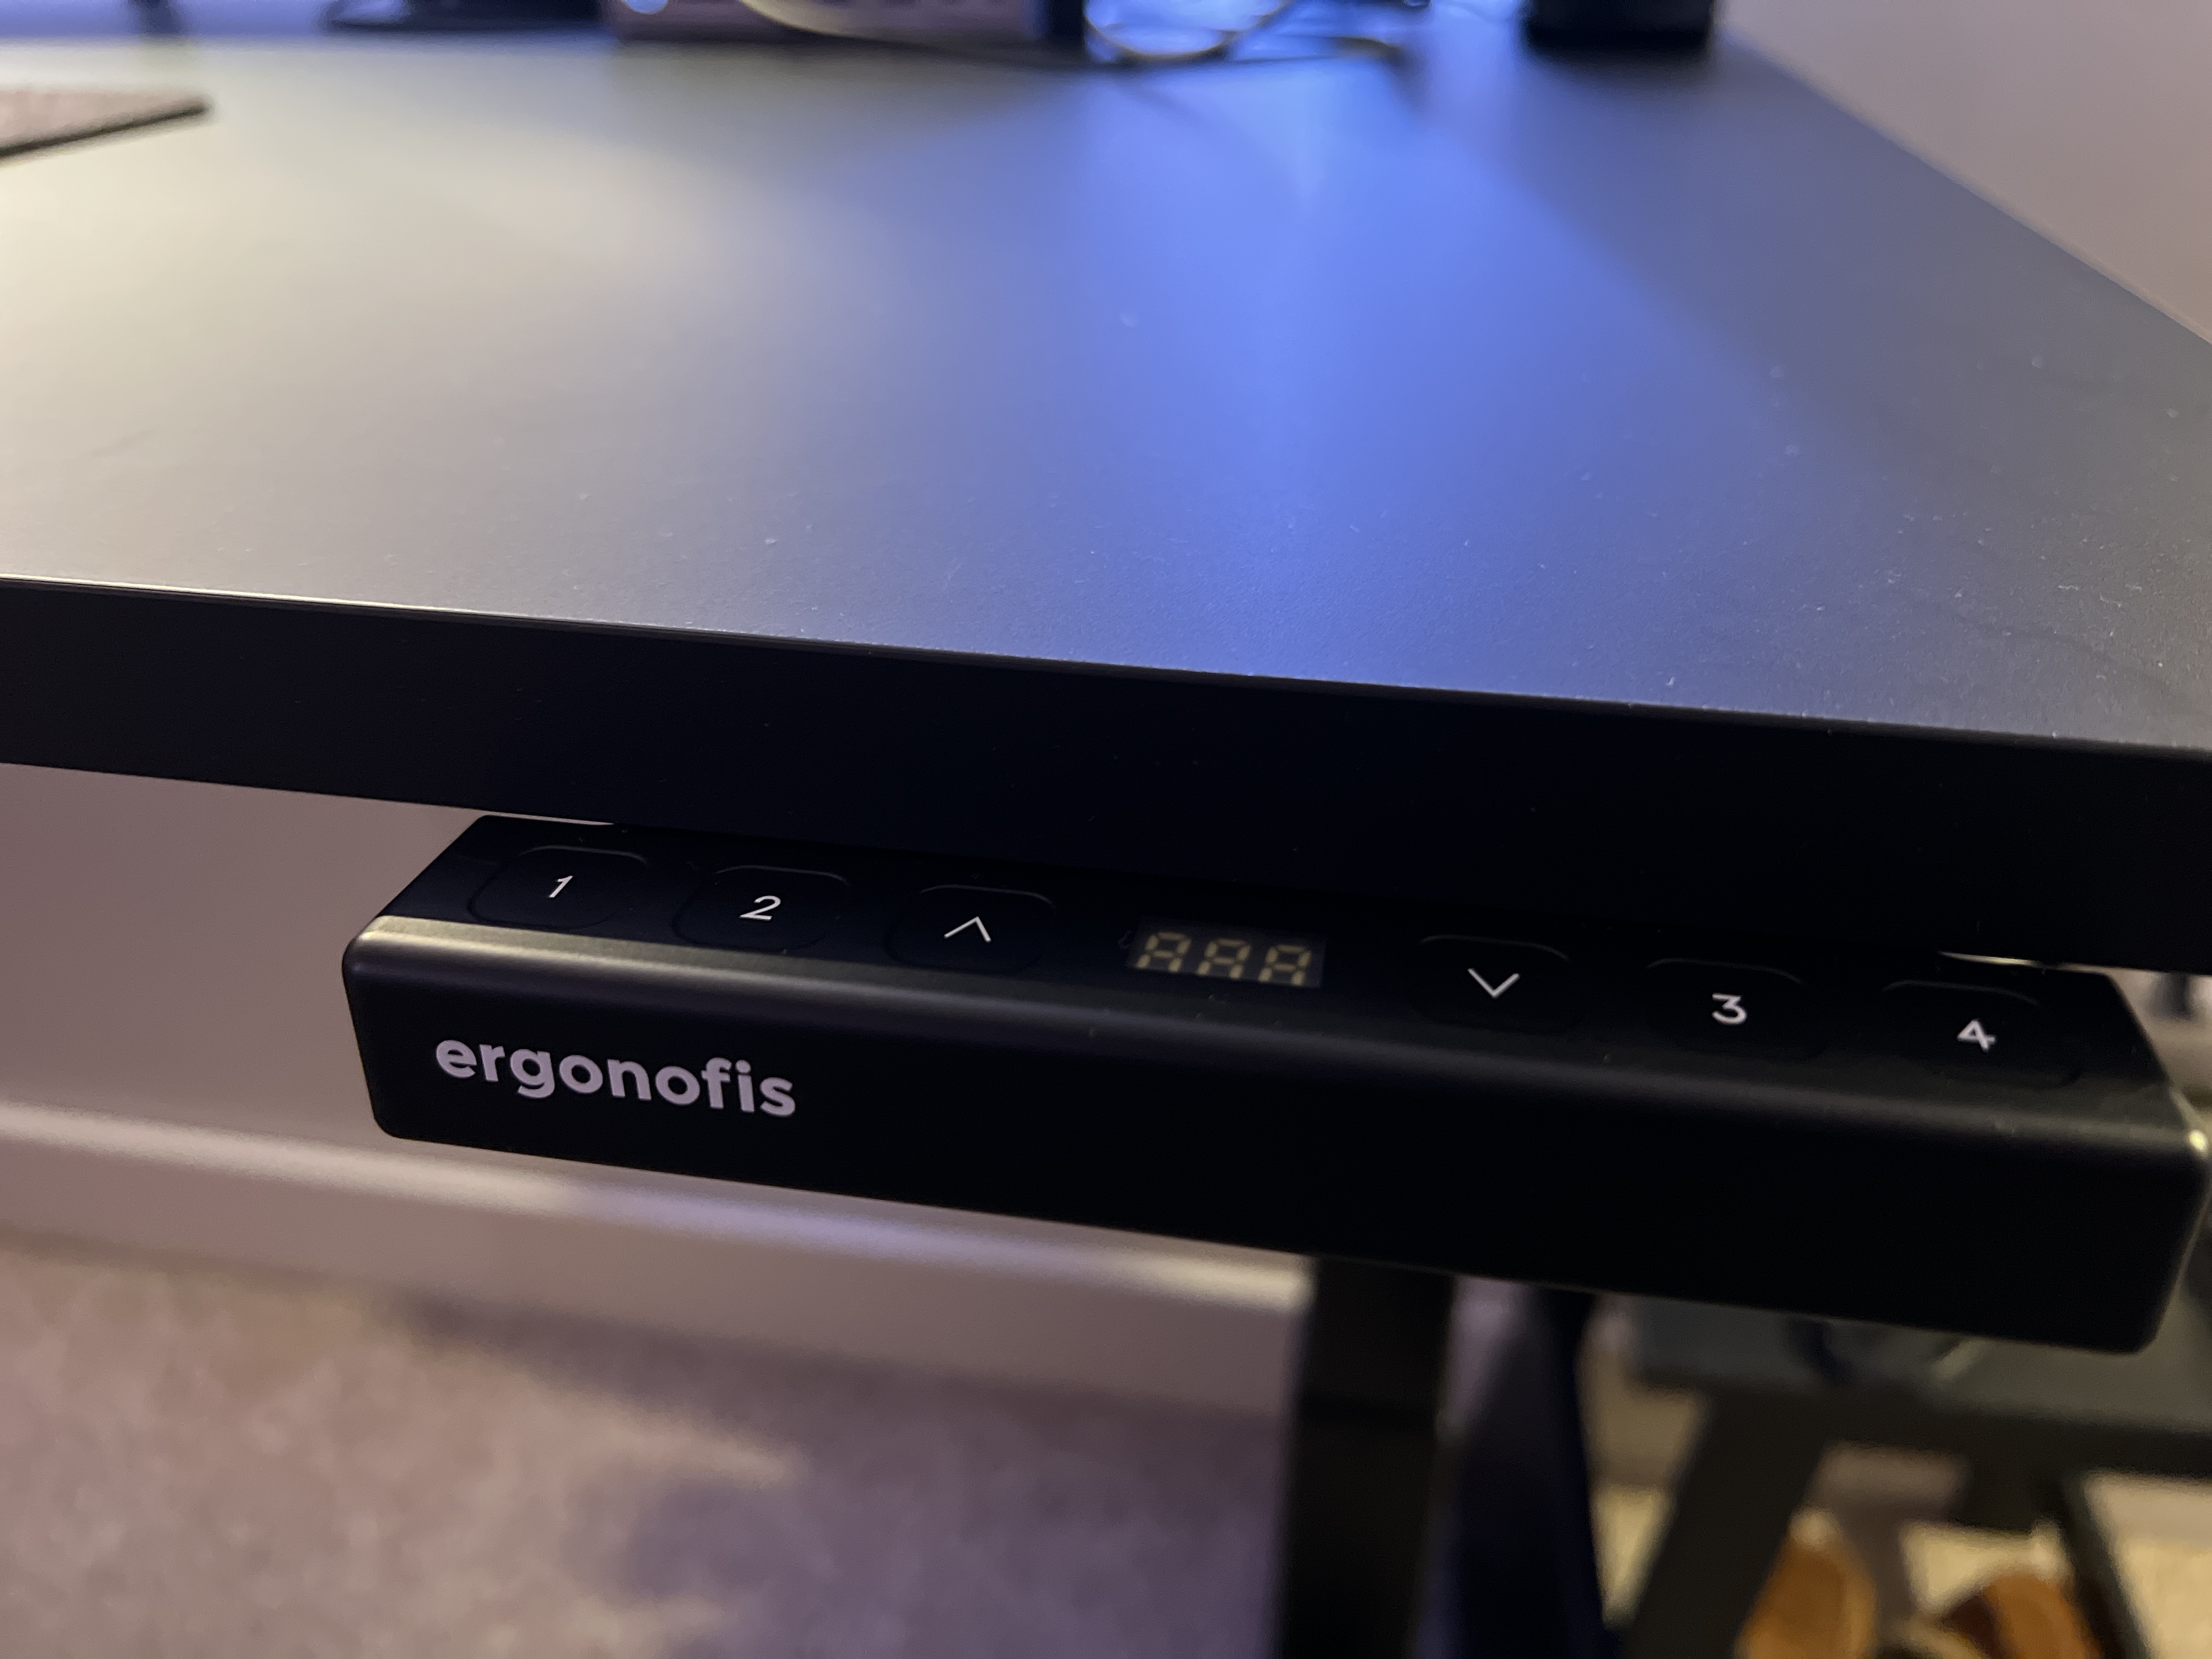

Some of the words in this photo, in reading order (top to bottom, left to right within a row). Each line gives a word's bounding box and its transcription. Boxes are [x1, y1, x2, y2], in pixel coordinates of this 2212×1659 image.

[549, 874, 573, 898] 1
[740, 895, 781, 921] 2
[1712, 994, 1747, 1024] 3
[1956, 1020, 1996, 1050] 4
[435, 1039, 796, 1116] ergonofis
